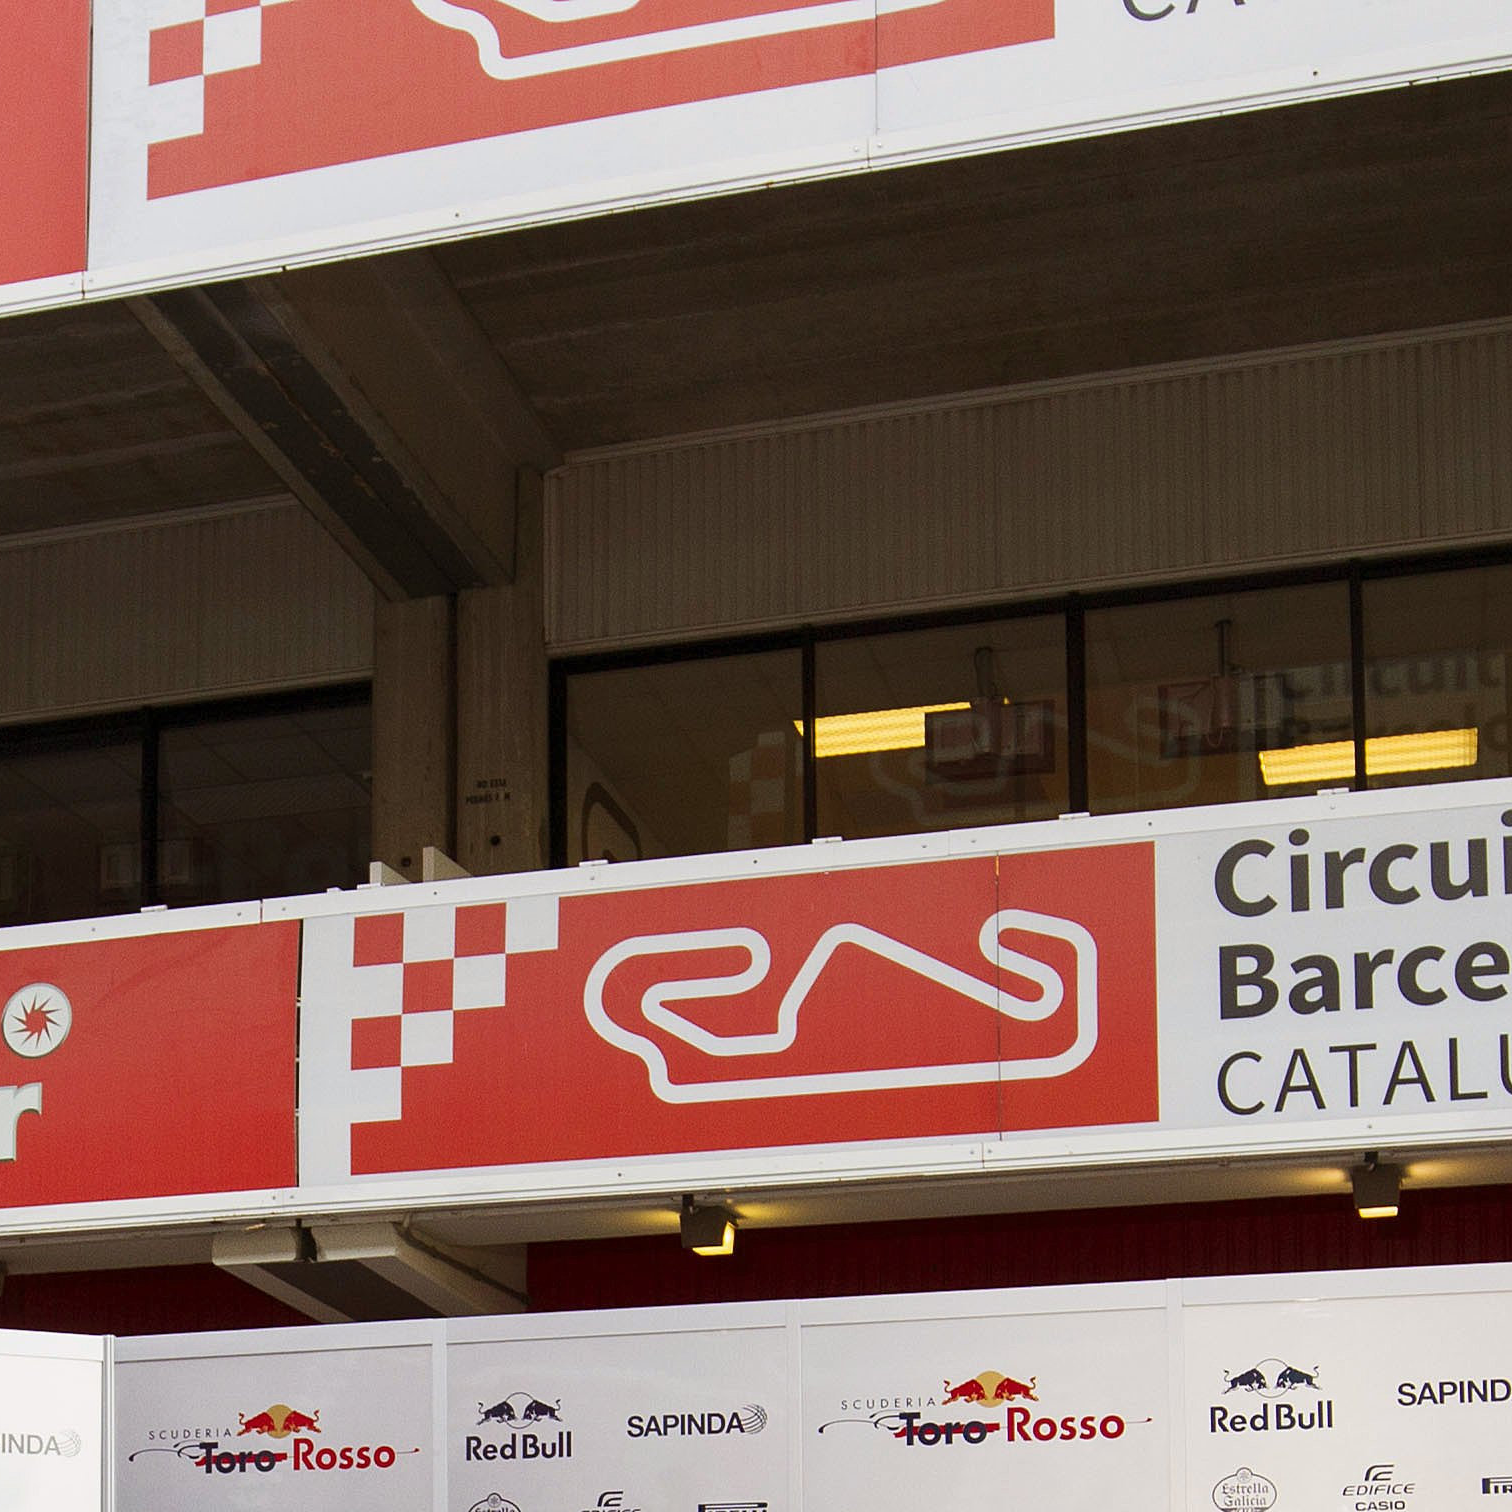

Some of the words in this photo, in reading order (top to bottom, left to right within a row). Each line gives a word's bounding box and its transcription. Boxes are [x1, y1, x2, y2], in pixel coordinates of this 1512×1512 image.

[841, 1397, 936, 1410] SCUDERIA
[1210, 1404, 1269, 1433] Red
[1275, 1400, 1333, 1430] Bull
[627, 1412, 745, 1438] SAPINDA
[899, 1411, 988, 1446] Toro
[1006, 1406, 1126, 1442] Rosso
[149, 1428, 232, 1440] SCUDERIA
[466, 1433, 516, 1461] Red
[523, 1431, 572, 1459] Bull
[199, 1441, 277, 1474] Toro
[292, 1437, 396, 1471] Rosso
[1222, 1482, 1269, 1496] Estrella
[1342, 1483, 1416, 1496] EDIFICE
[1223, 1495, 1267, 1508] Galicia
[1355, 1500, 1406, 1512] CASIO
